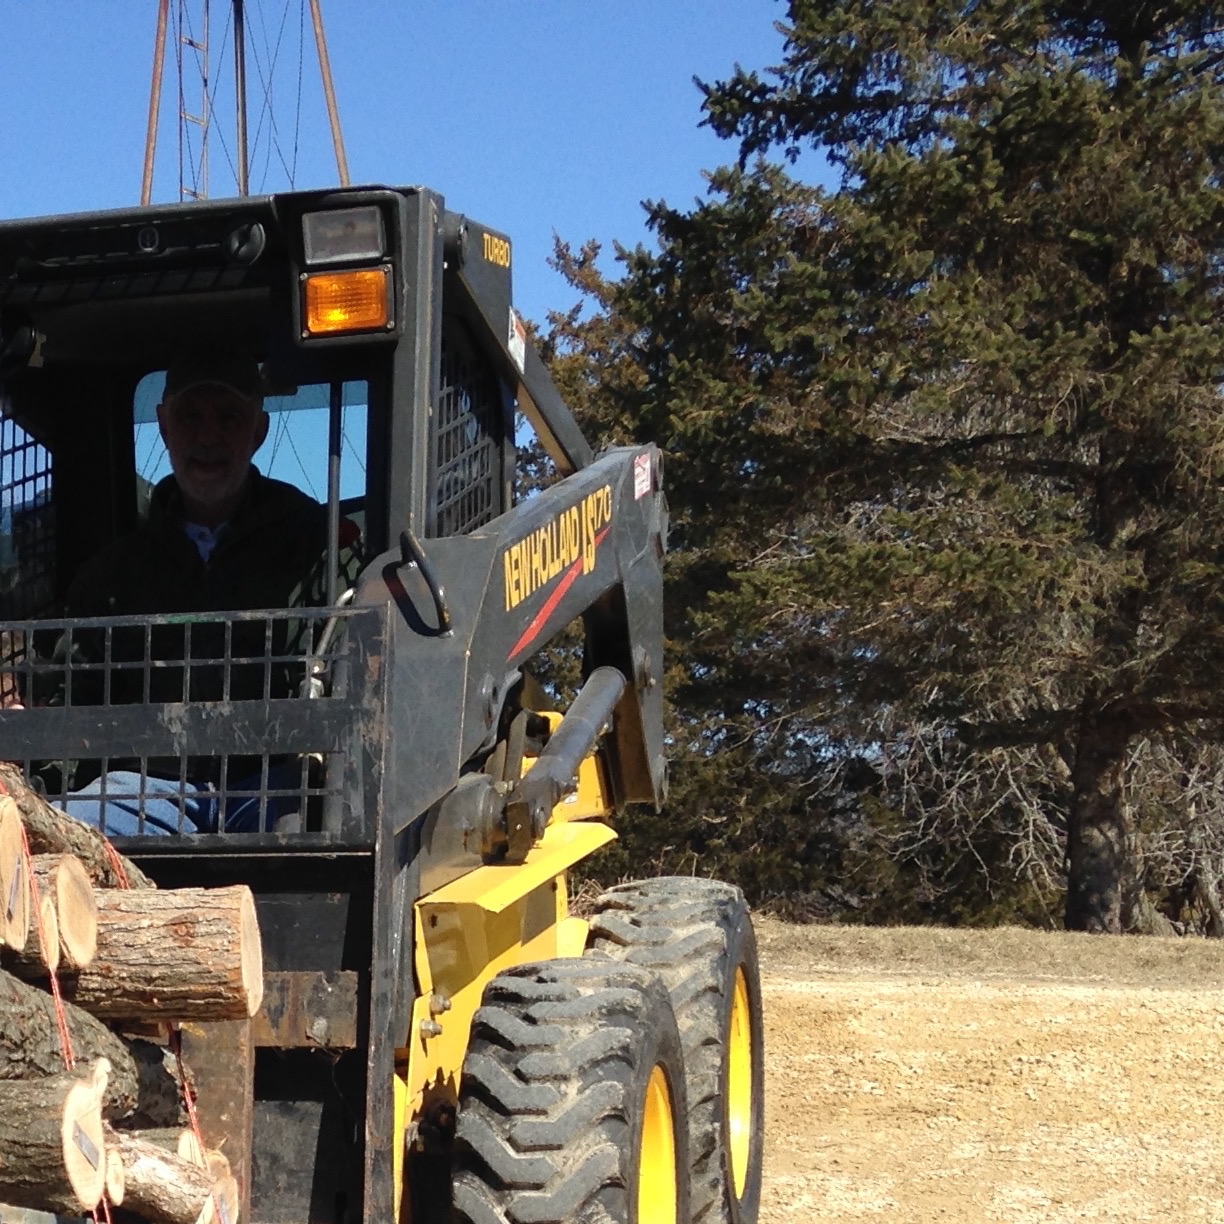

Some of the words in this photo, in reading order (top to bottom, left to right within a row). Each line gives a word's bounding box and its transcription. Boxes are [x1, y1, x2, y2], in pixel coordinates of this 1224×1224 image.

[483, 233, 510, 267] TURBO
[504, 536, 531, 612] NEW
[531, 506, 579, 592] HOLLAND
